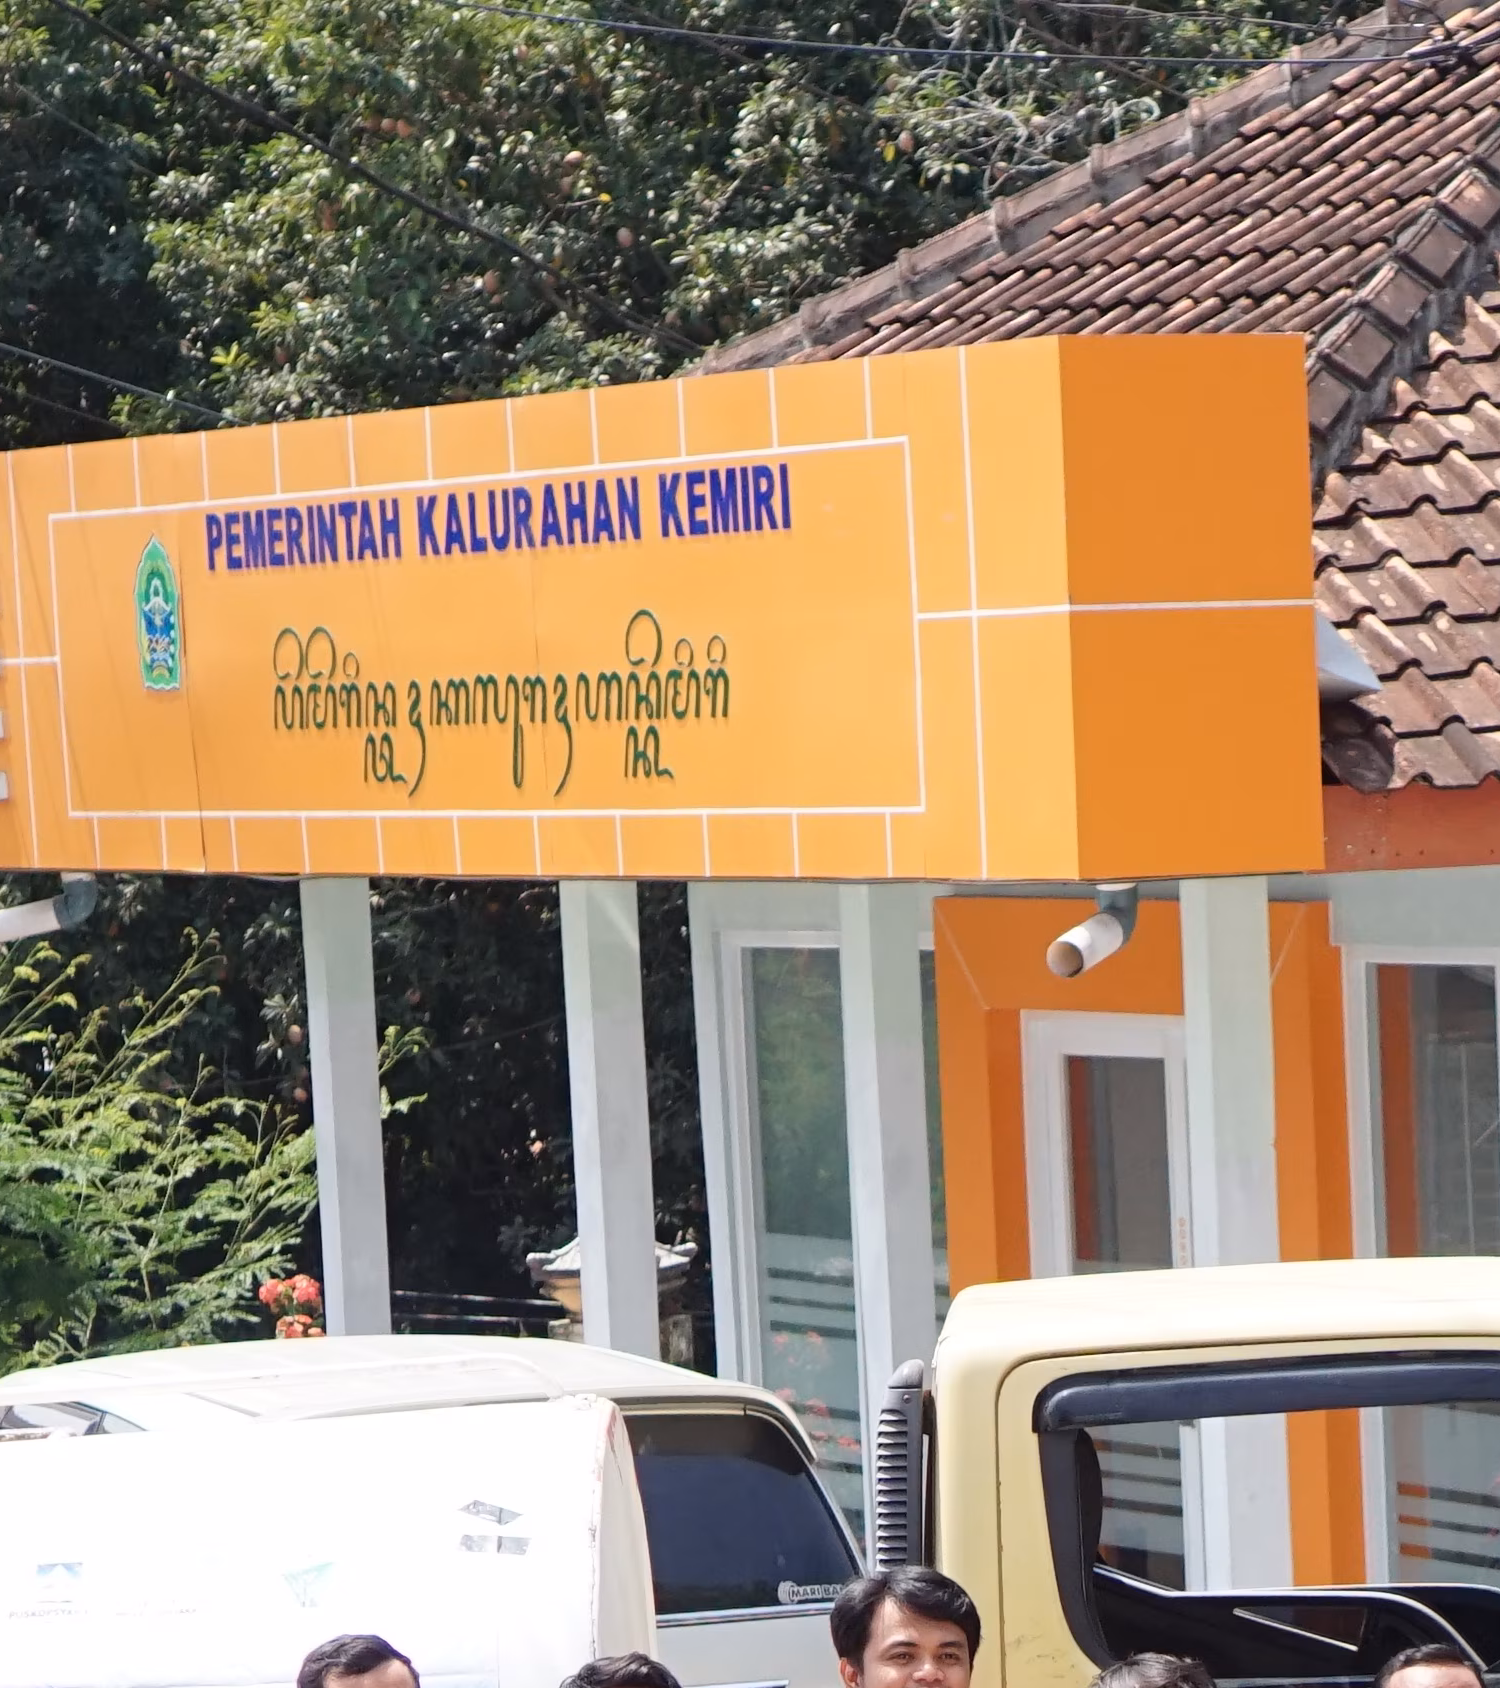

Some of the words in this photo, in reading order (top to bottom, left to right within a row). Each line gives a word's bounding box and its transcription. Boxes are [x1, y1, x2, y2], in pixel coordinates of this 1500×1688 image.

[205, 497, 401, 571] PEMERINTAH
[415, 475, 642, 556] KALURAHAN
[658, 462, 792, 538] KEMIRI
